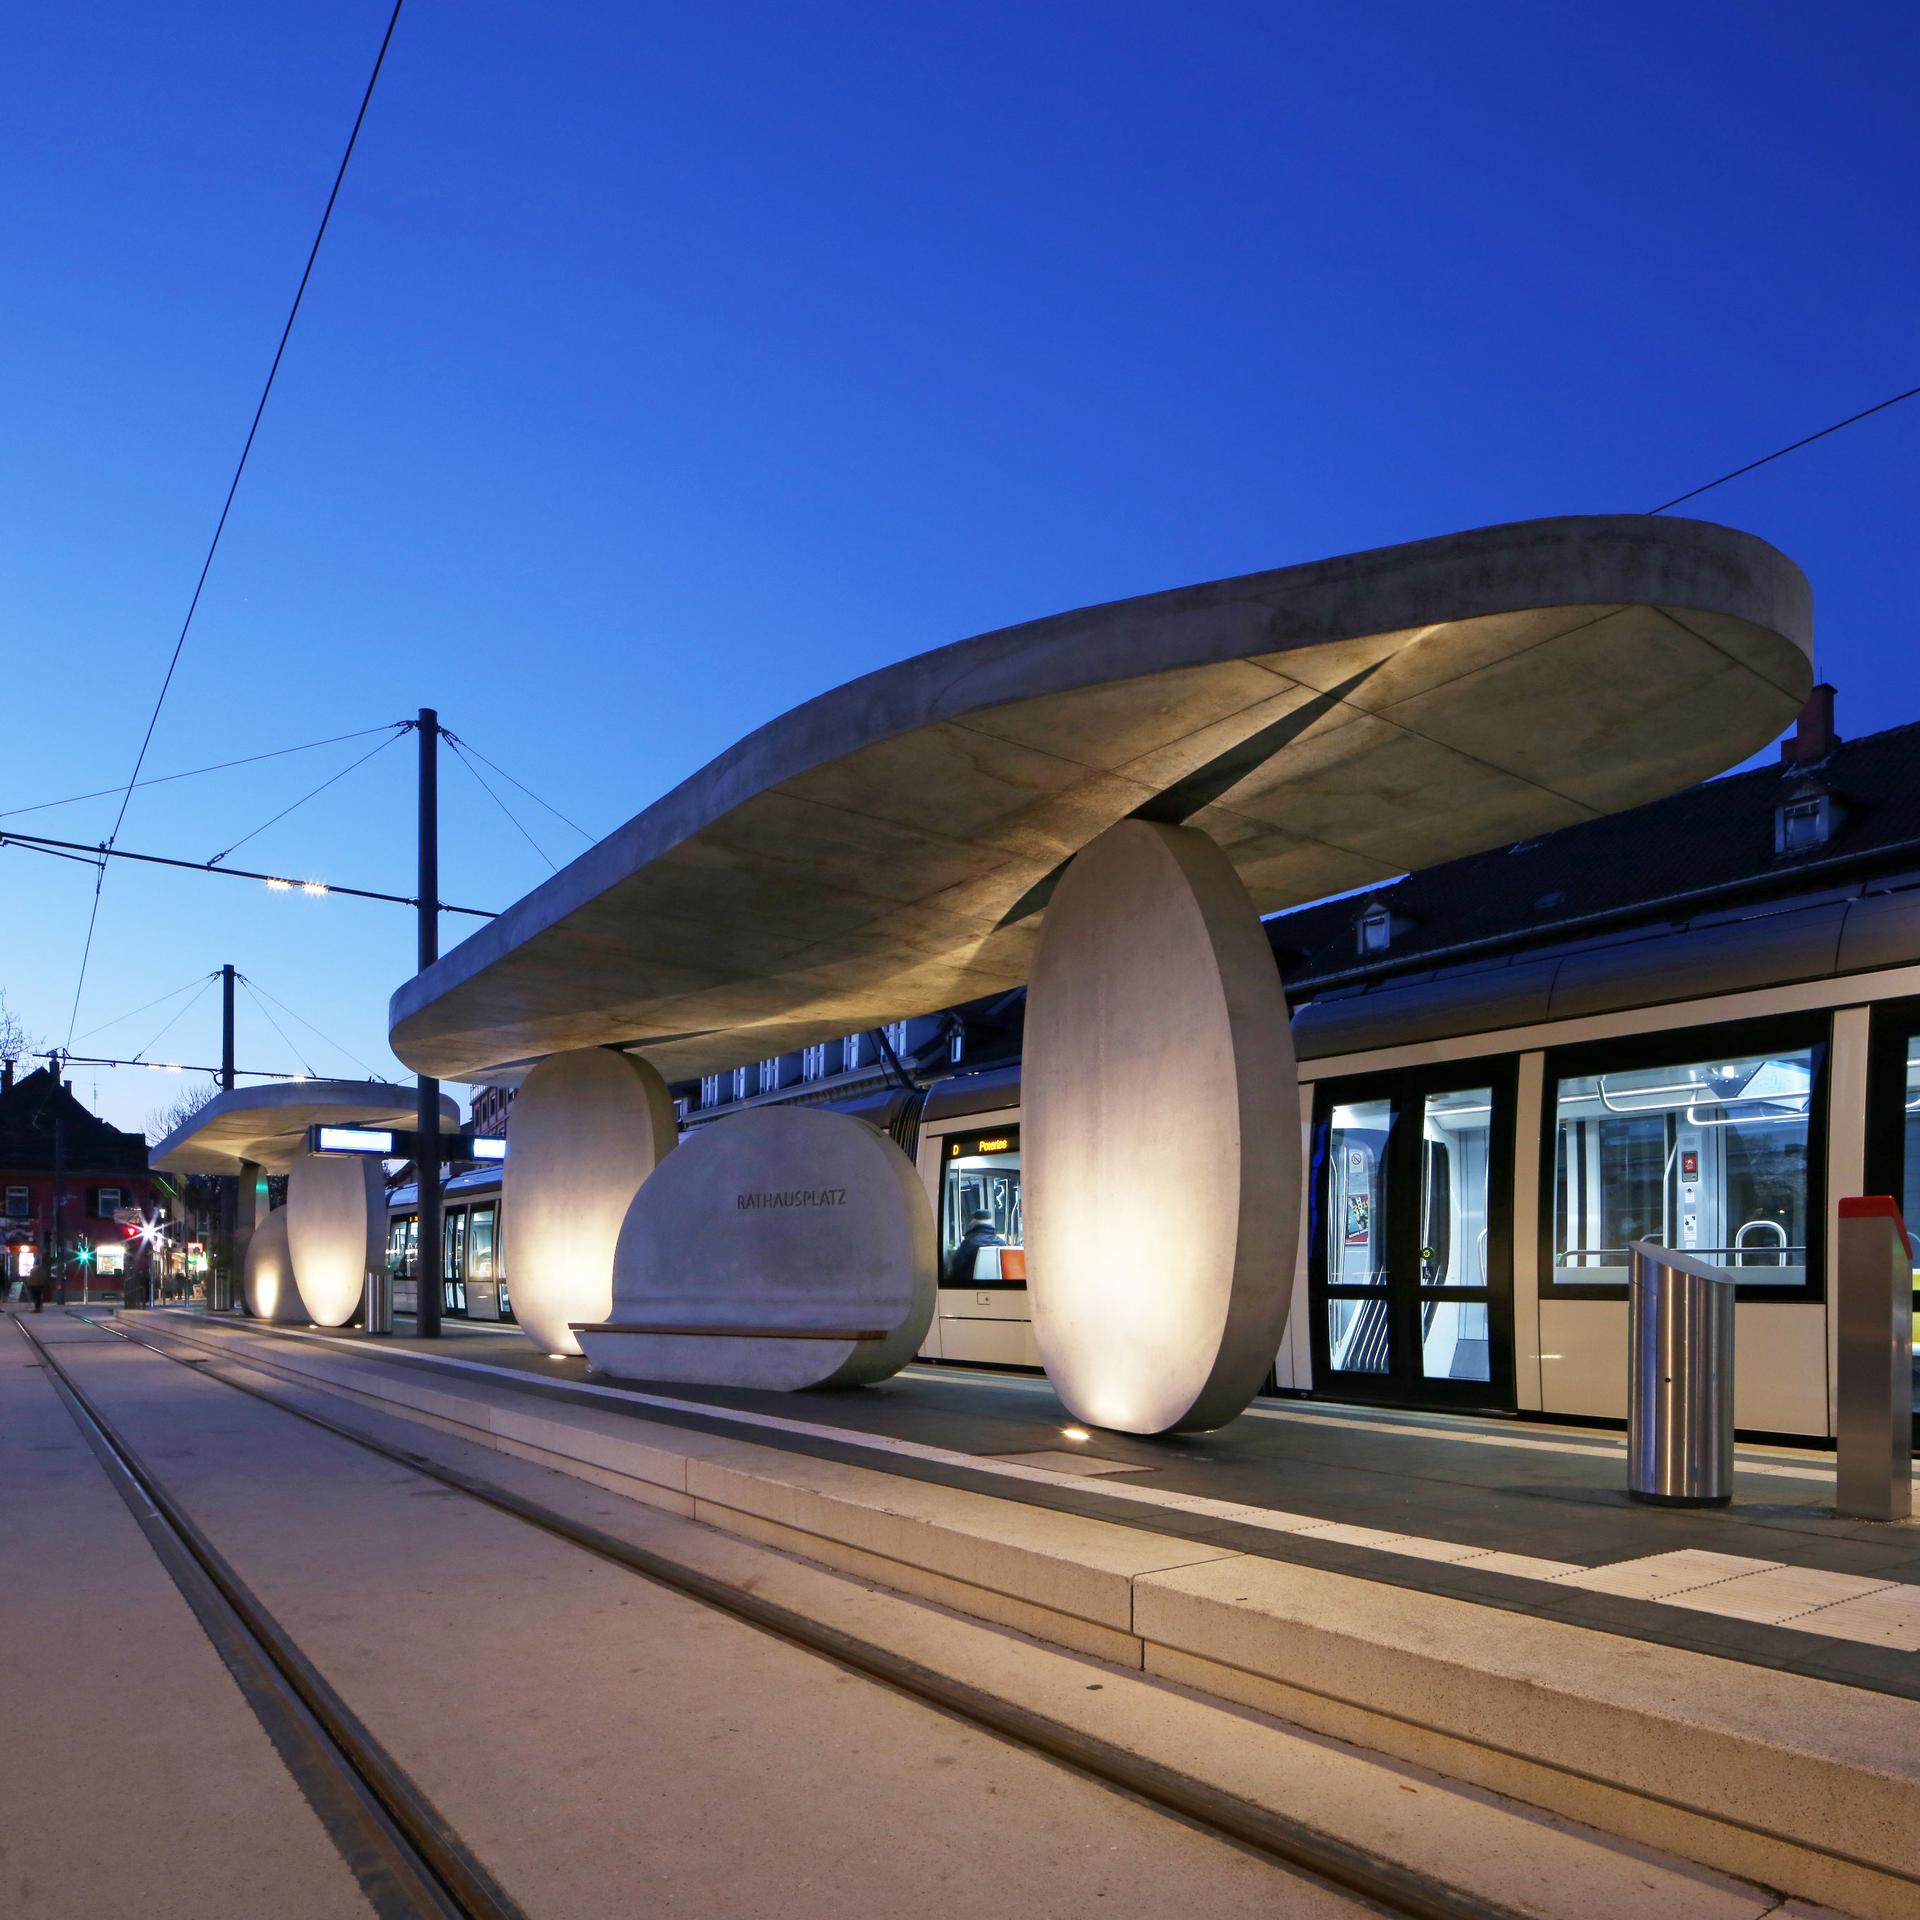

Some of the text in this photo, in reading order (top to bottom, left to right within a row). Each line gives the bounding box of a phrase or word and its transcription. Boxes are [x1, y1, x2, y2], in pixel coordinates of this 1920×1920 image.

[952, 1139, 1008, 1156] D Poteries
[737, 1188, 847, 1210] RATHAUSPLATZ
